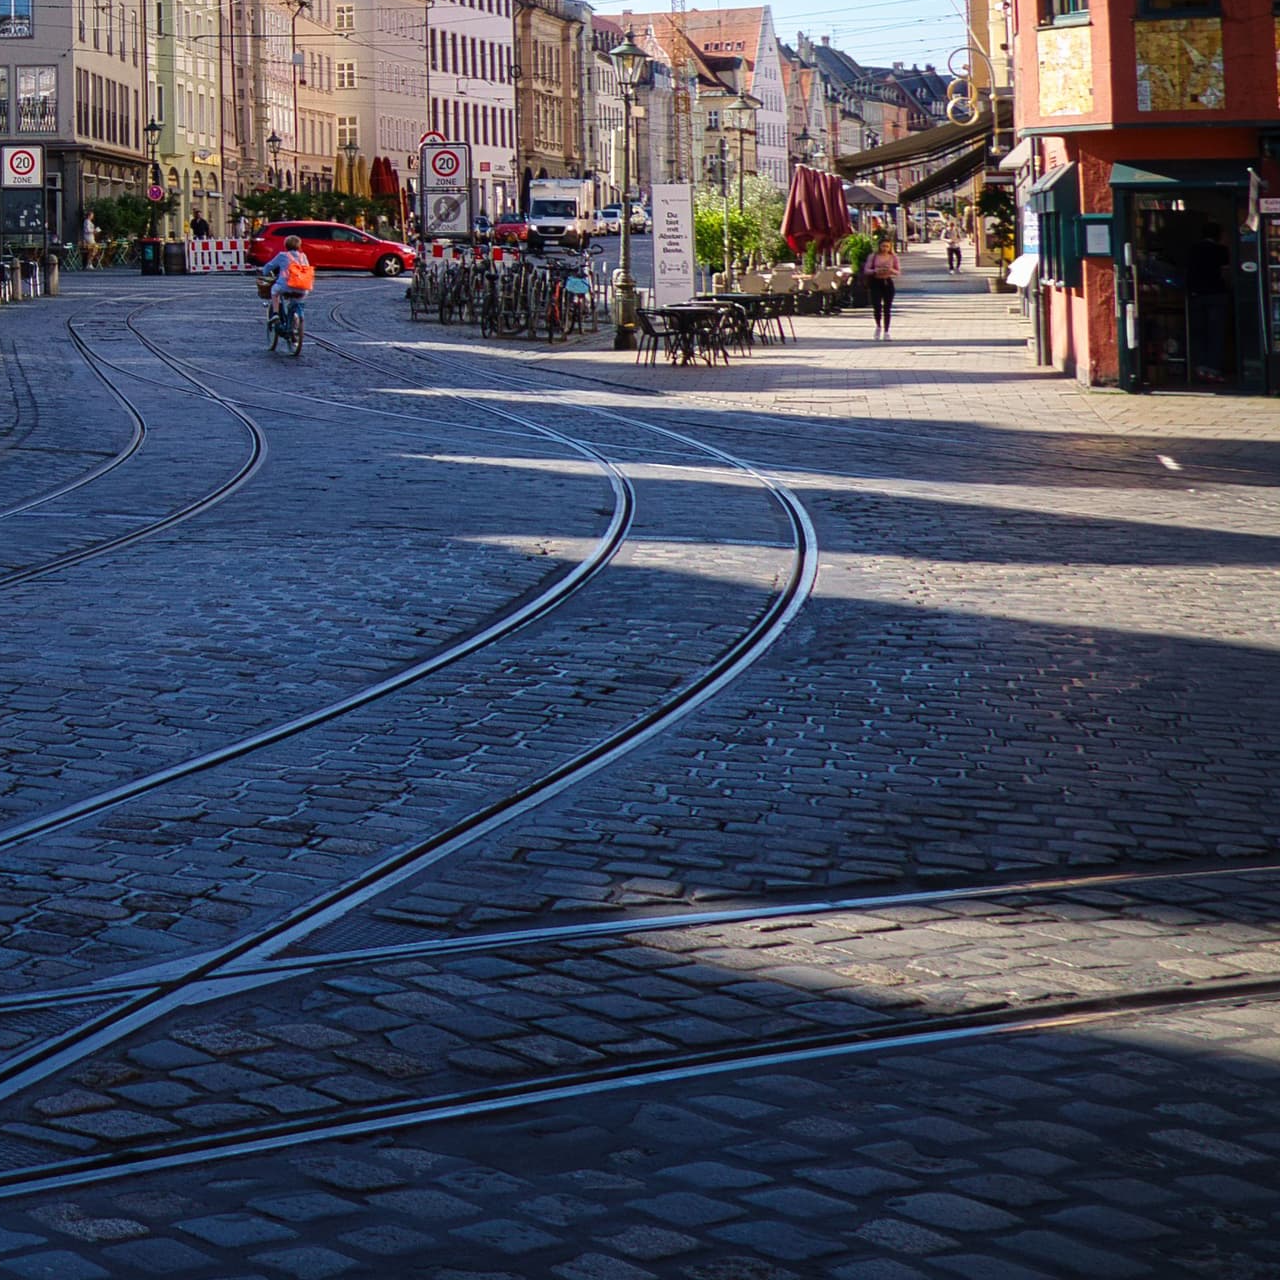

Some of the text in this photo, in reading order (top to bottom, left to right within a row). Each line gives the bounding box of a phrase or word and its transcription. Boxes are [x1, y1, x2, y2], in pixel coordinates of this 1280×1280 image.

[15, 156, 30, 169] 20
[438, 157, 455, 170] 20
[12, 176, 33, 184] ZONE
[436, 178, 457, 186] ZONE
[666, 211, 678, 219] Du
